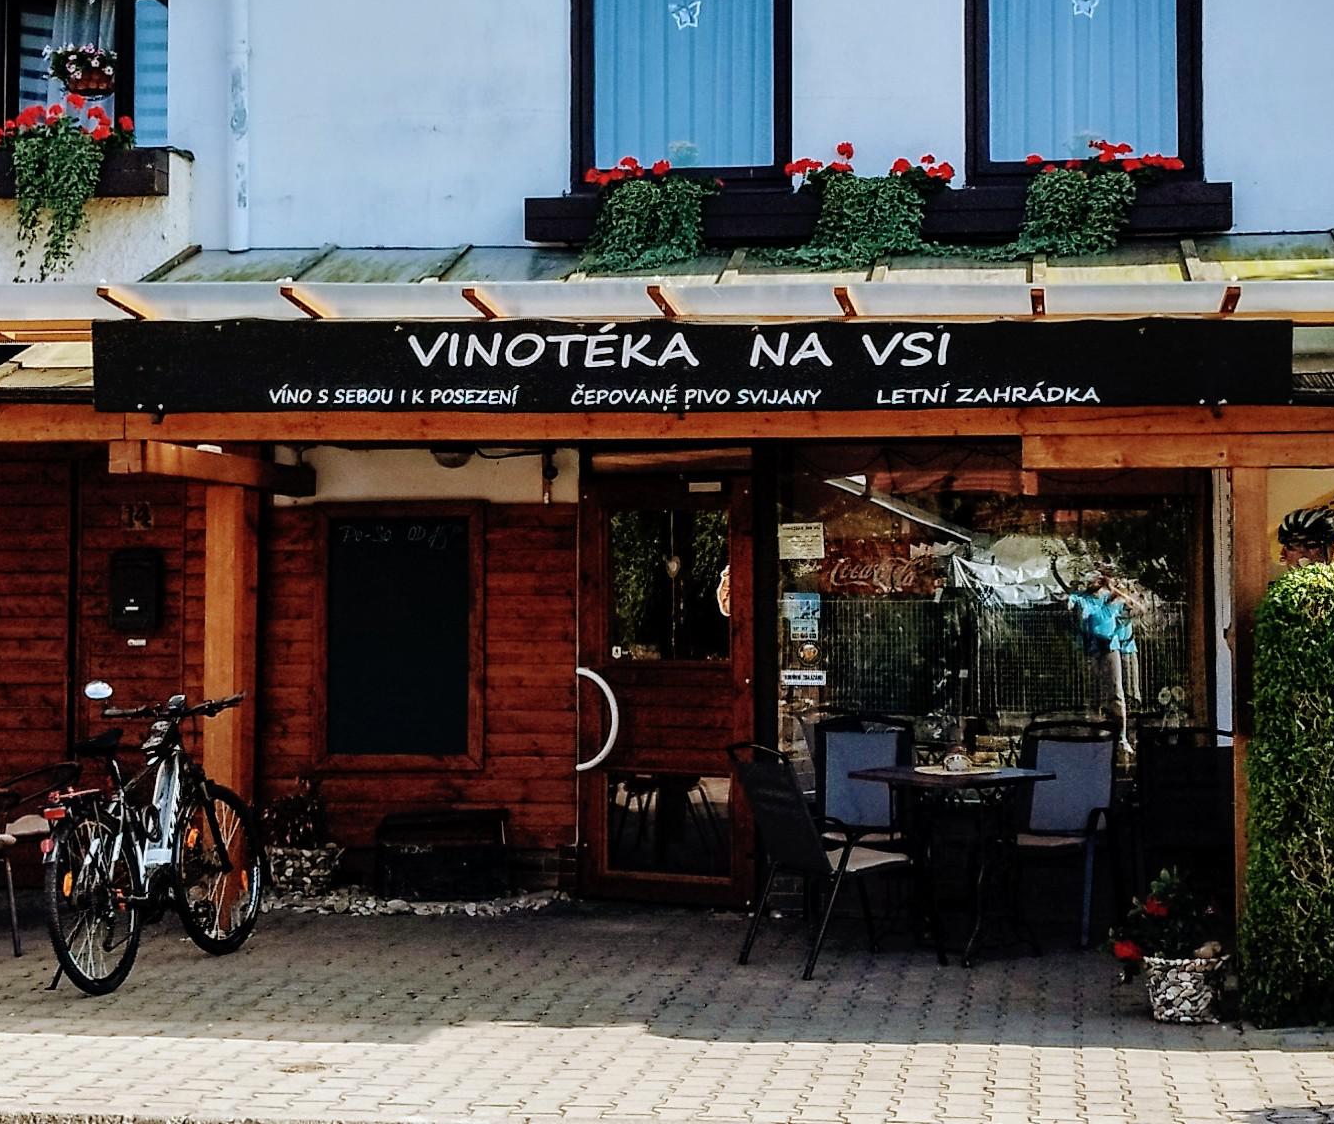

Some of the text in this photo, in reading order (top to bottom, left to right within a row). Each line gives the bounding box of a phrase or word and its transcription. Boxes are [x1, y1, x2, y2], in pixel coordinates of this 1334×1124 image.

[408, 323, 950, 368] VINOTÉKA NA VSI
[268, 383, 520, 407] VÍNO S SEBOU I K POSEZENÍ
[570, 383, 822, 405] ČEPOVANÉ PIVO SVIJANY
[876, 380, 1101, 405] LETNÍ ZAHRÁDKA
